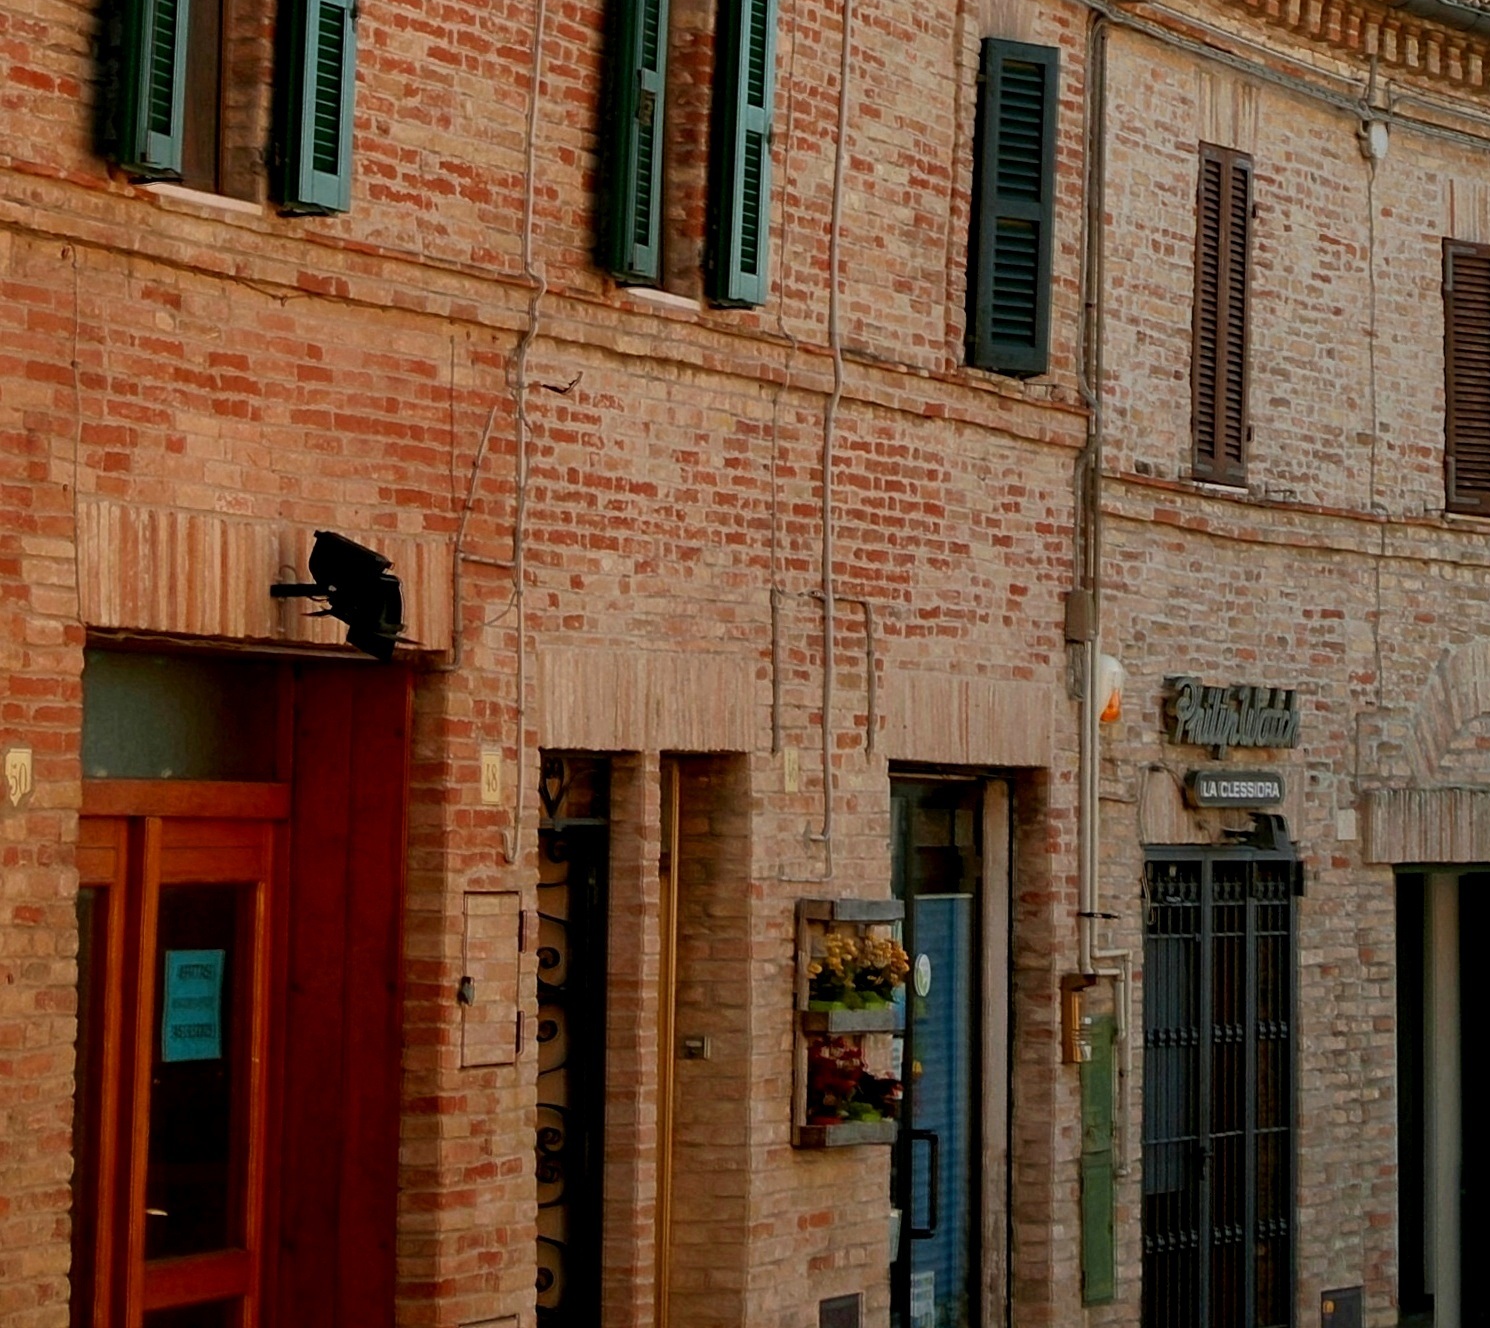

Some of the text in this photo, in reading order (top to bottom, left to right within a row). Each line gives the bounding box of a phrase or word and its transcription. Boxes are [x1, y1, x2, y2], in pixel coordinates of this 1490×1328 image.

[1175, 678, 1298, 760] Philip Watch
[1201, 780, 1281, 799] LA CLESSIDRA
